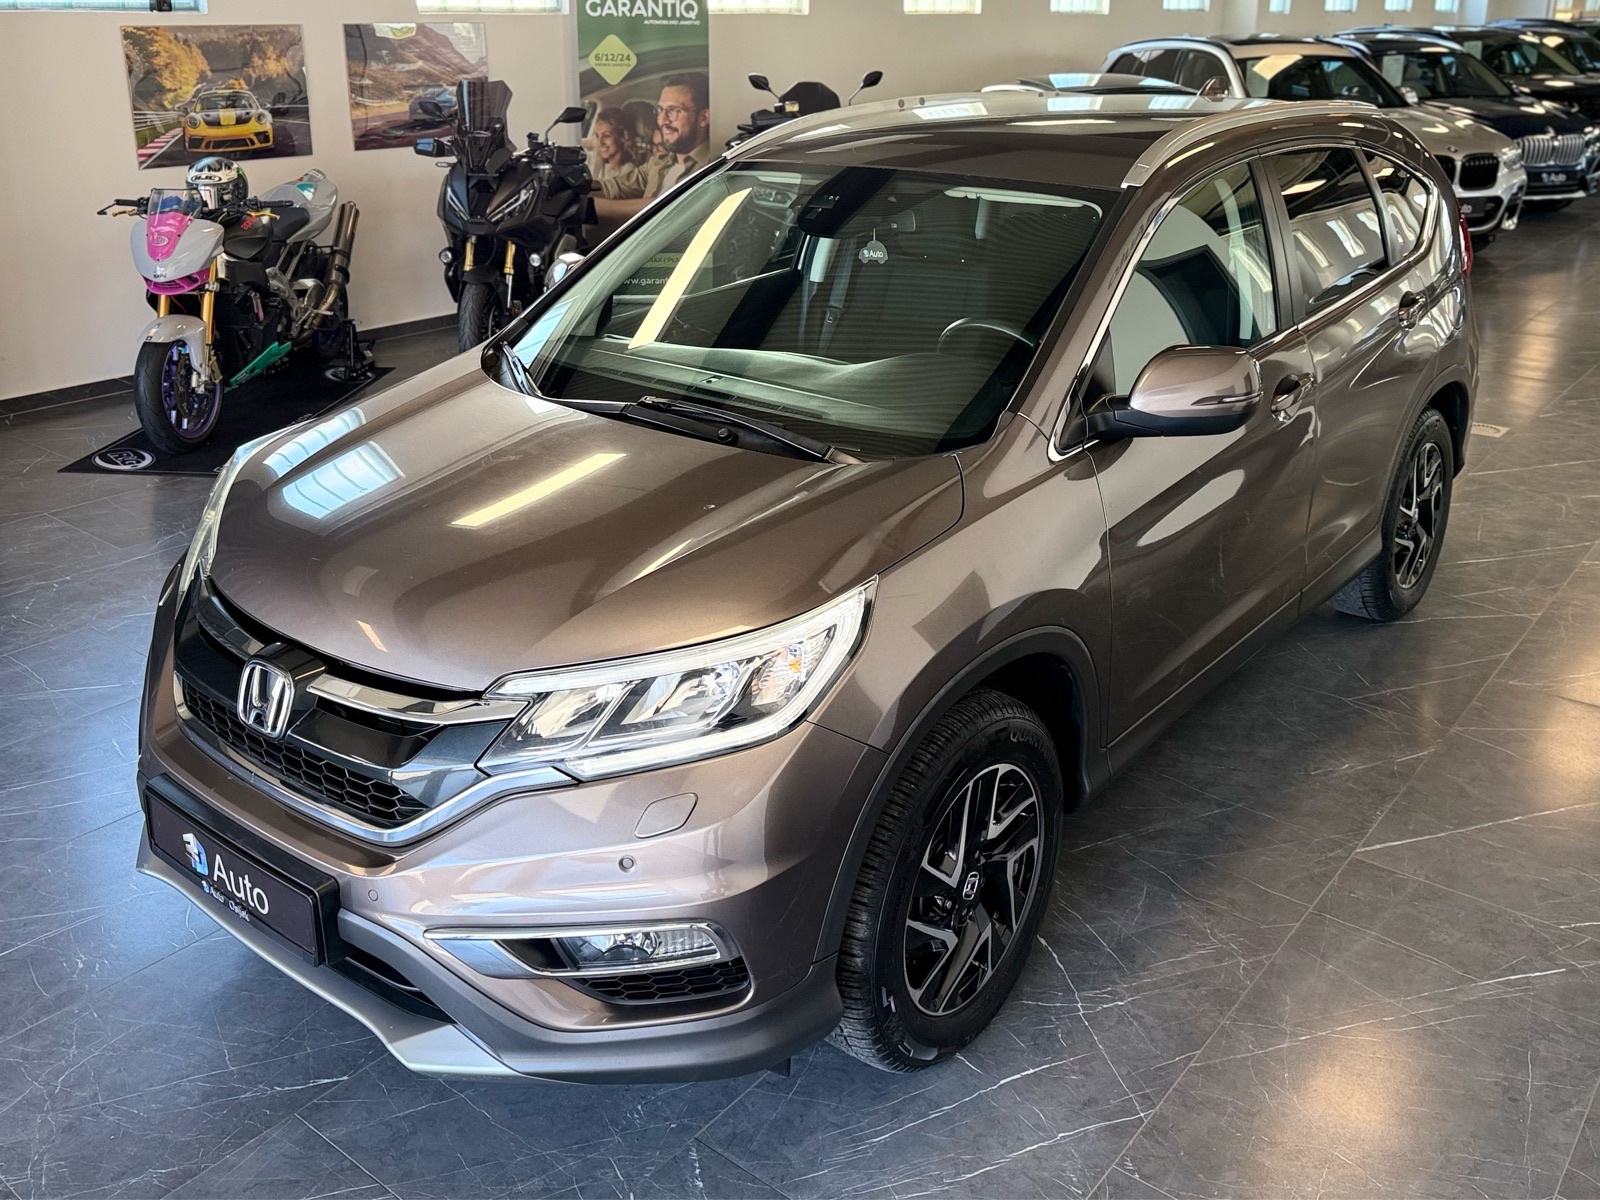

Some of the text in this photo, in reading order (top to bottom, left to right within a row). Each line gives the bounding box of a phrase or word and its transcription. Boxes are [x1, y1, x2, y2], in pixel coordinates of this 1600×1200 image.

[585, 0, 699, 19] GARANTIQ
[594, 53, 631, 62] 6/12/24
[869, 249, 884, 258] Auto
[213, 853, 269, 915] Auto
